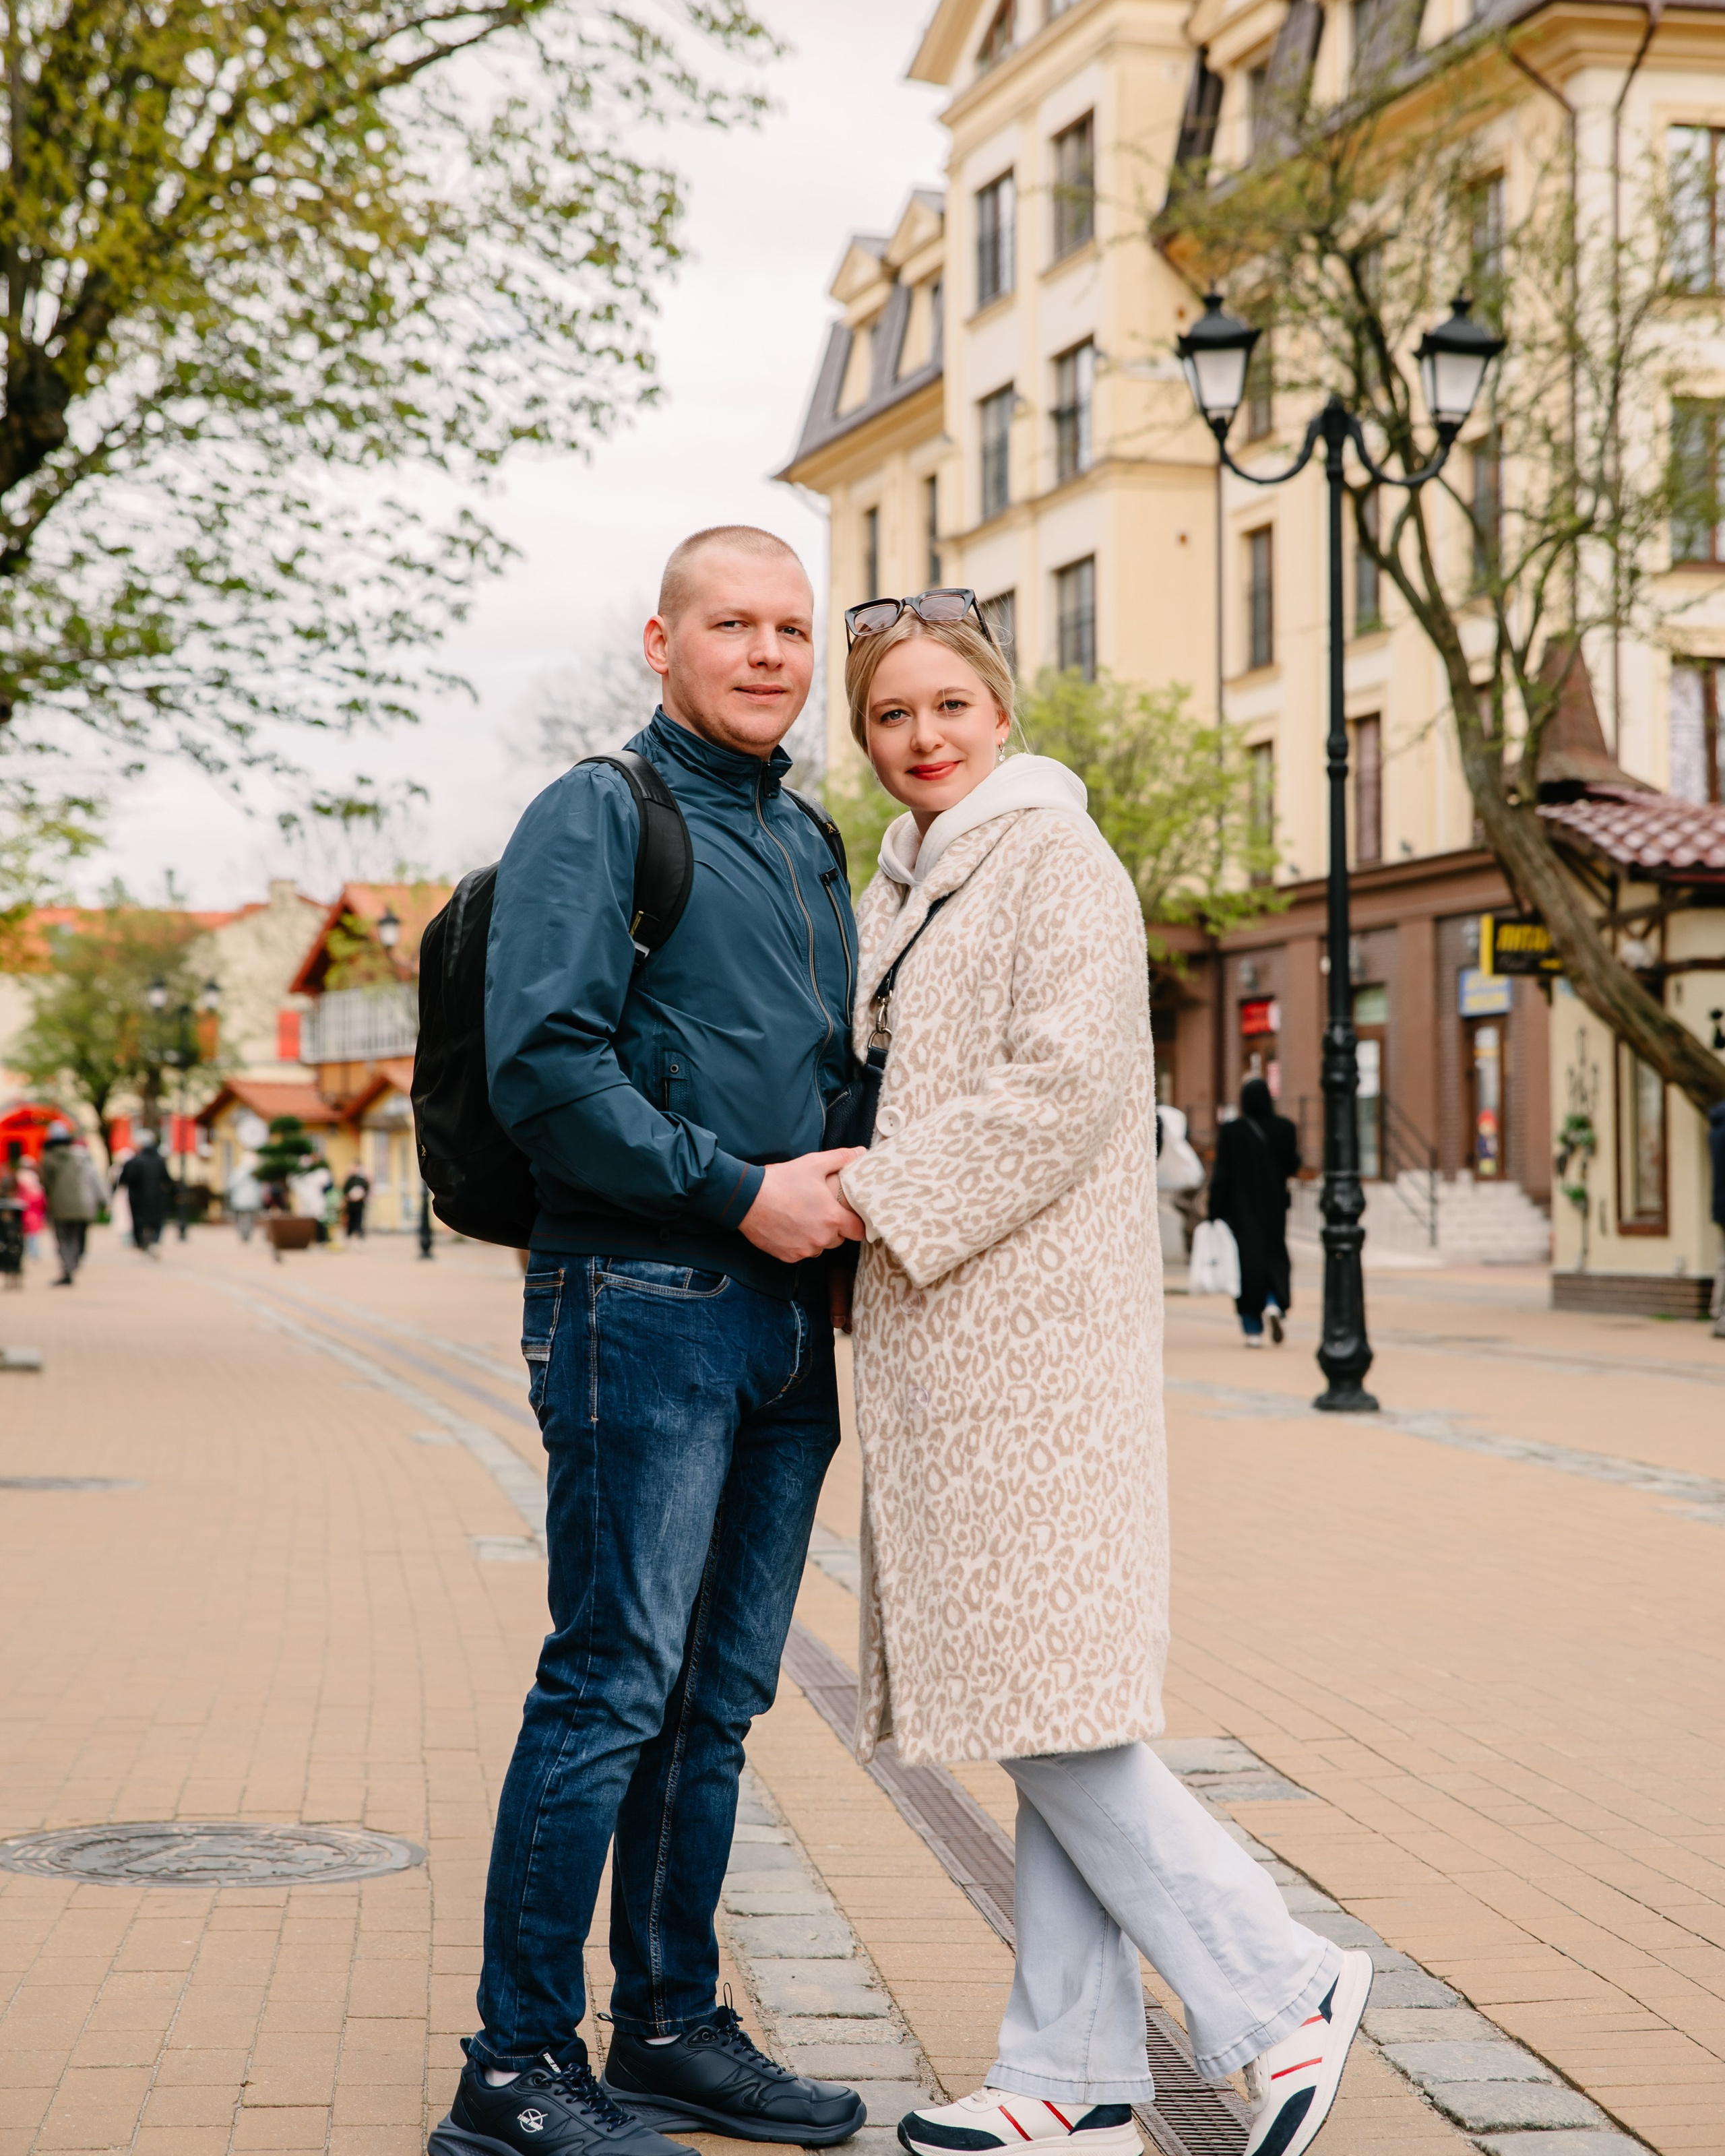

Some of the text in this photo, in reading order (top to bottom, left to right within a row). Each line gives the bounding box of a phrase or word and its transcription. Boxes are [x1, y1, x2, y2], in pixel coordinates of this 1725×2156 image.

[542, 2052, 555, 2066] TIME
[517, 2114, 544, 2131] TIME JUMP
